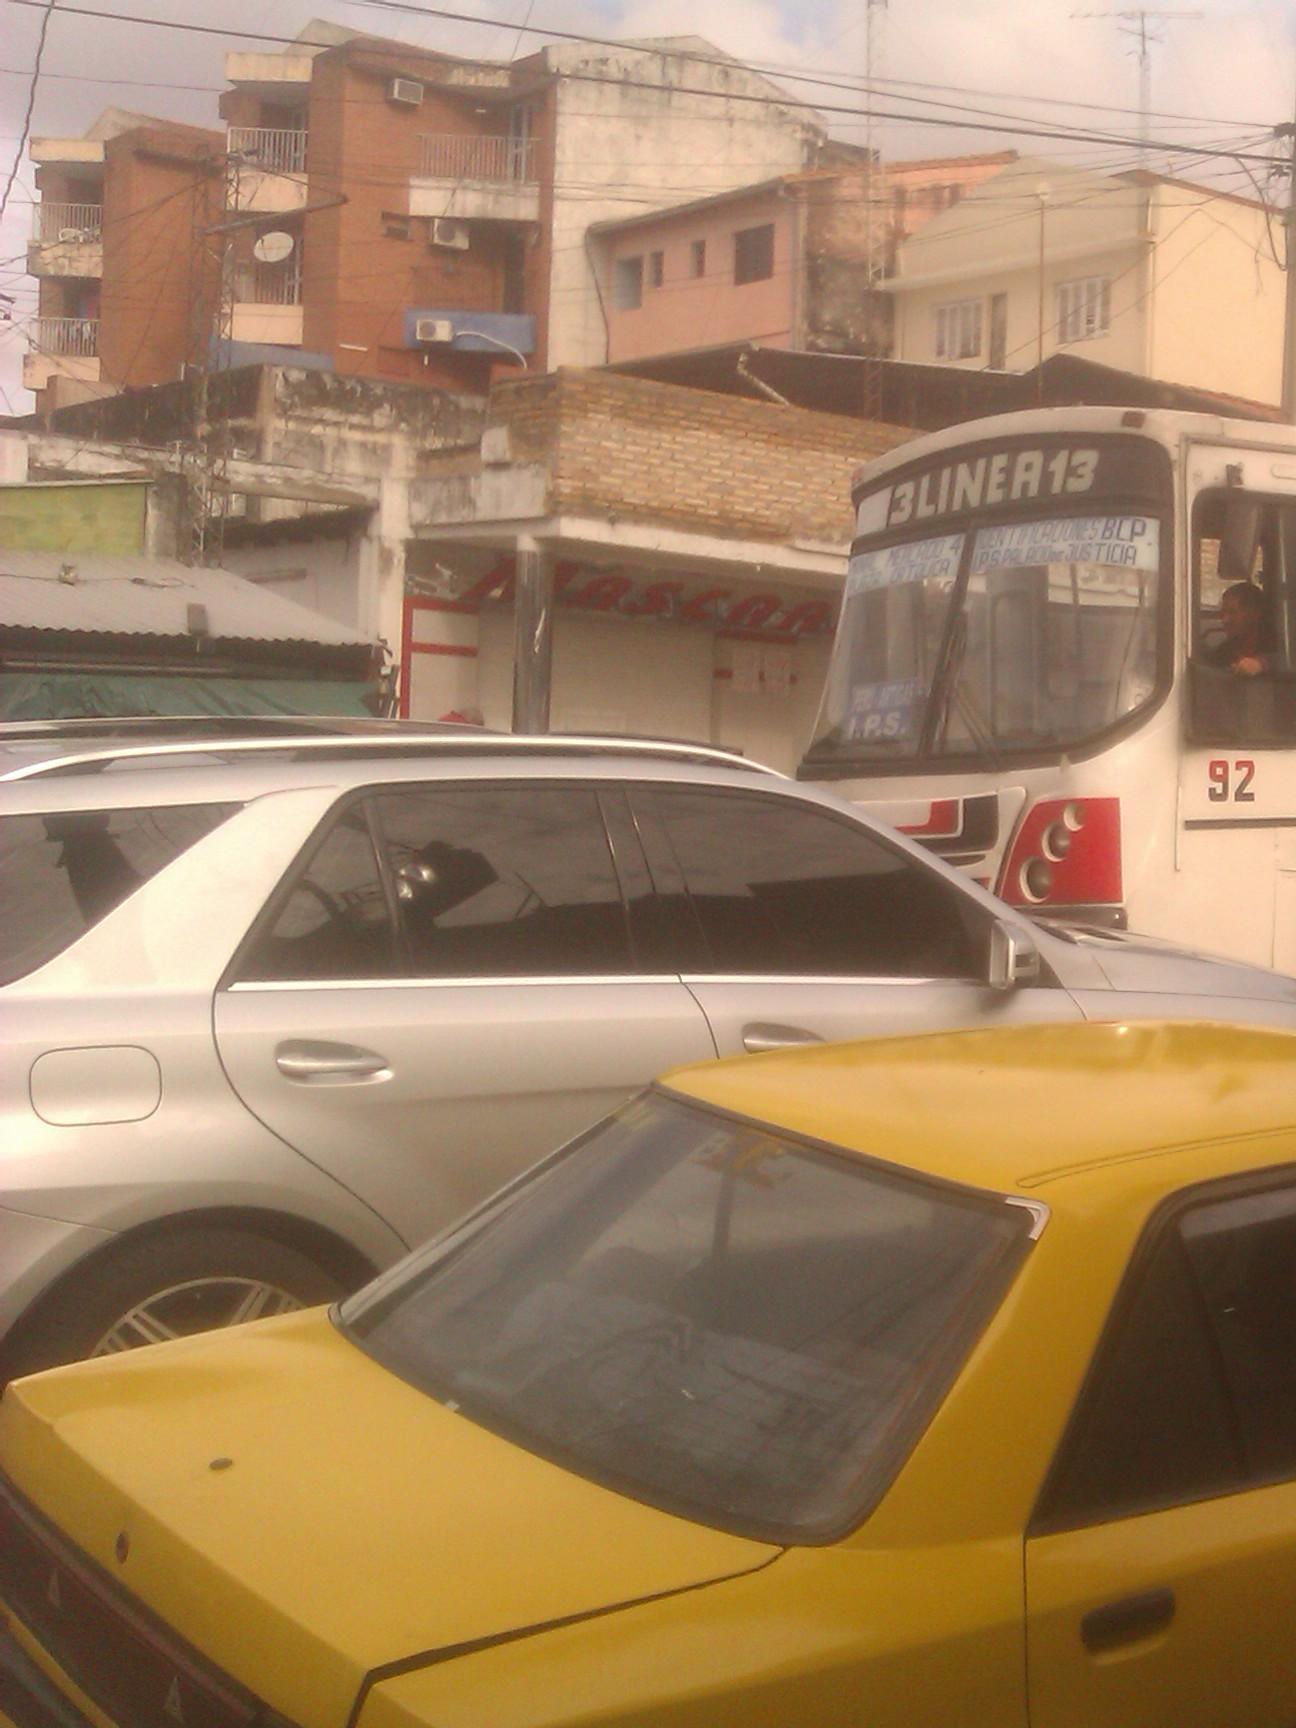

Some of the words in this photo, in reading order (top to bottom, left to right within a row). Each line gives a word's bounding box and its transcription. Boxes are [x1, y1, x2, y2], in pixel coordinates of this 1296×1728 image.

[1100, 517, 1147, 543] BCP
[1064, 542, 1138, 566] JUSTICIA
[1208, 760, 1255, 802] 92
